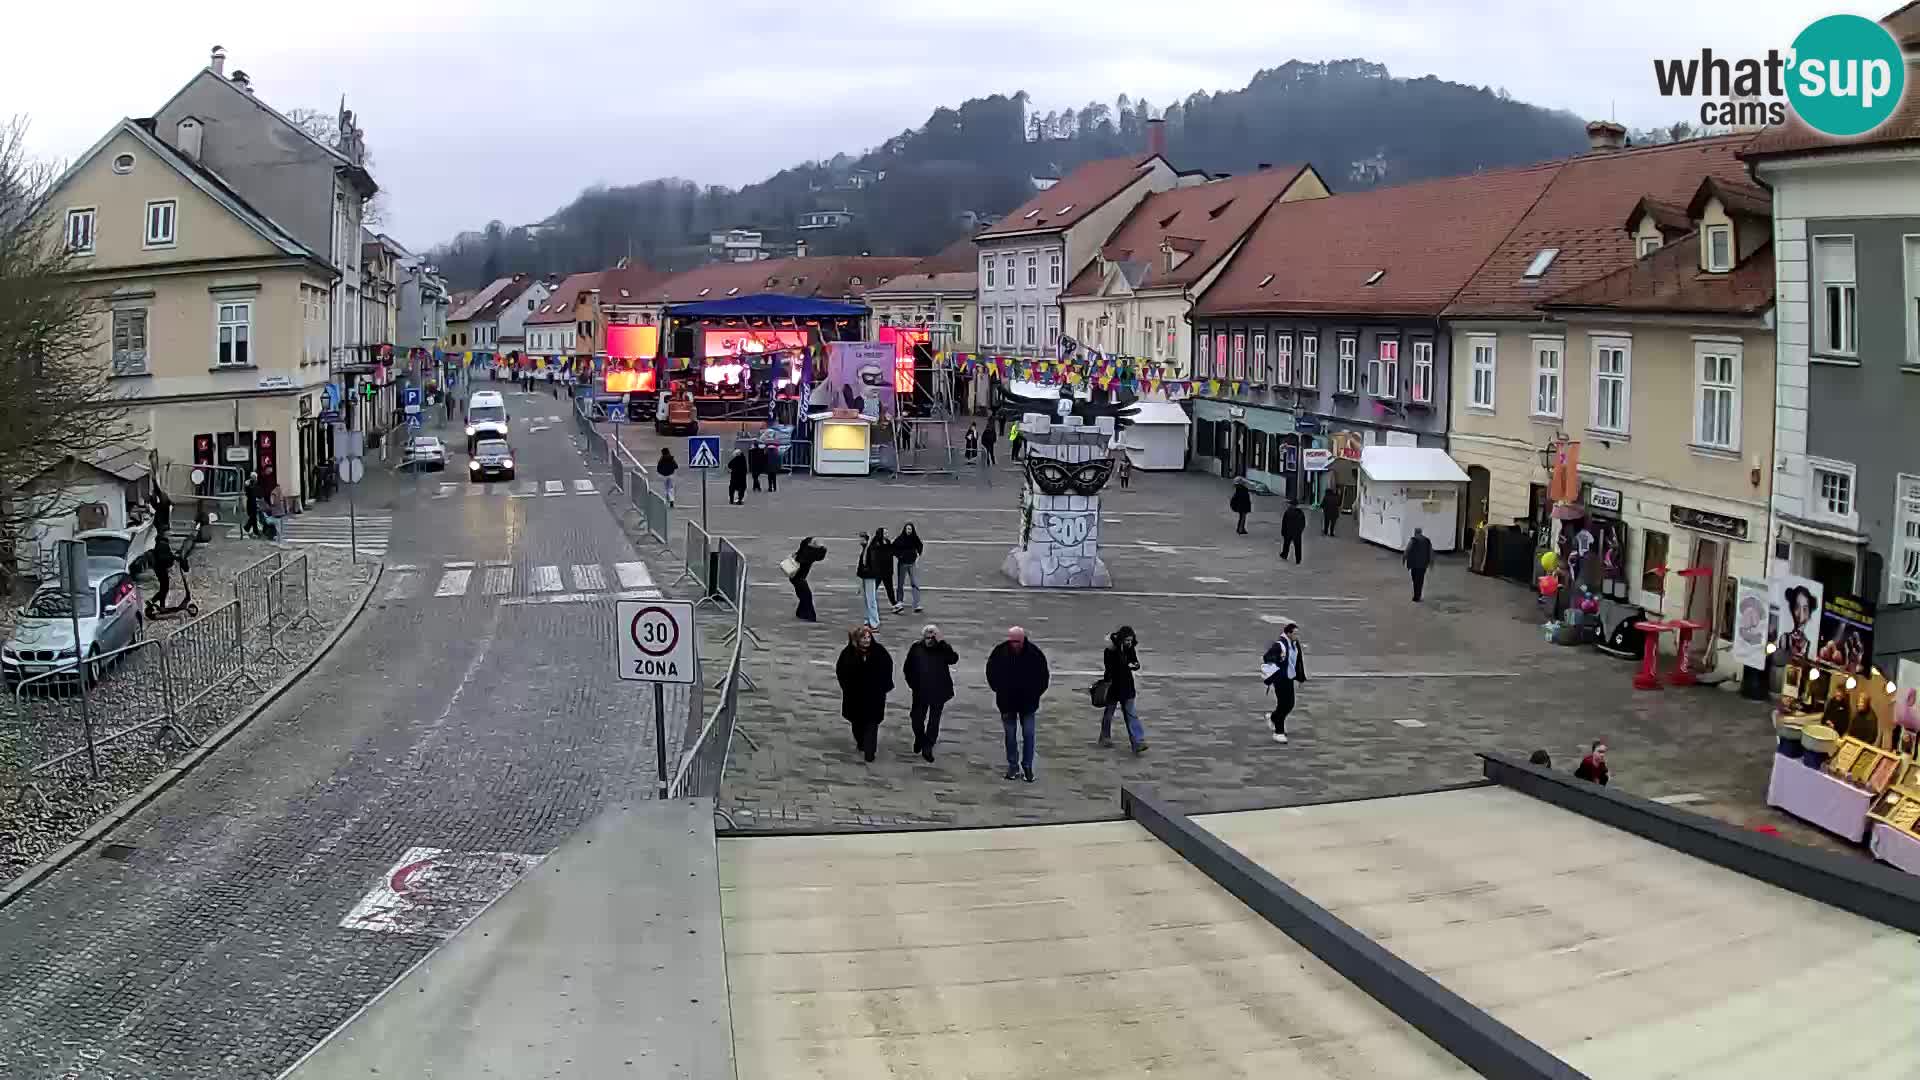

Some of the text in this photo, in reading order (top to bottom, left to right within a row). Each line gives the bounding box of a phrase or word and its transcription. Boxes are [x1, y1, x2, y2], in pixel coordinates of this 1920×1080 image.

[409, 391, 417, 403] P
[643, 622, 668, 643] 30
[633, 659, 678, 677] ZONA
